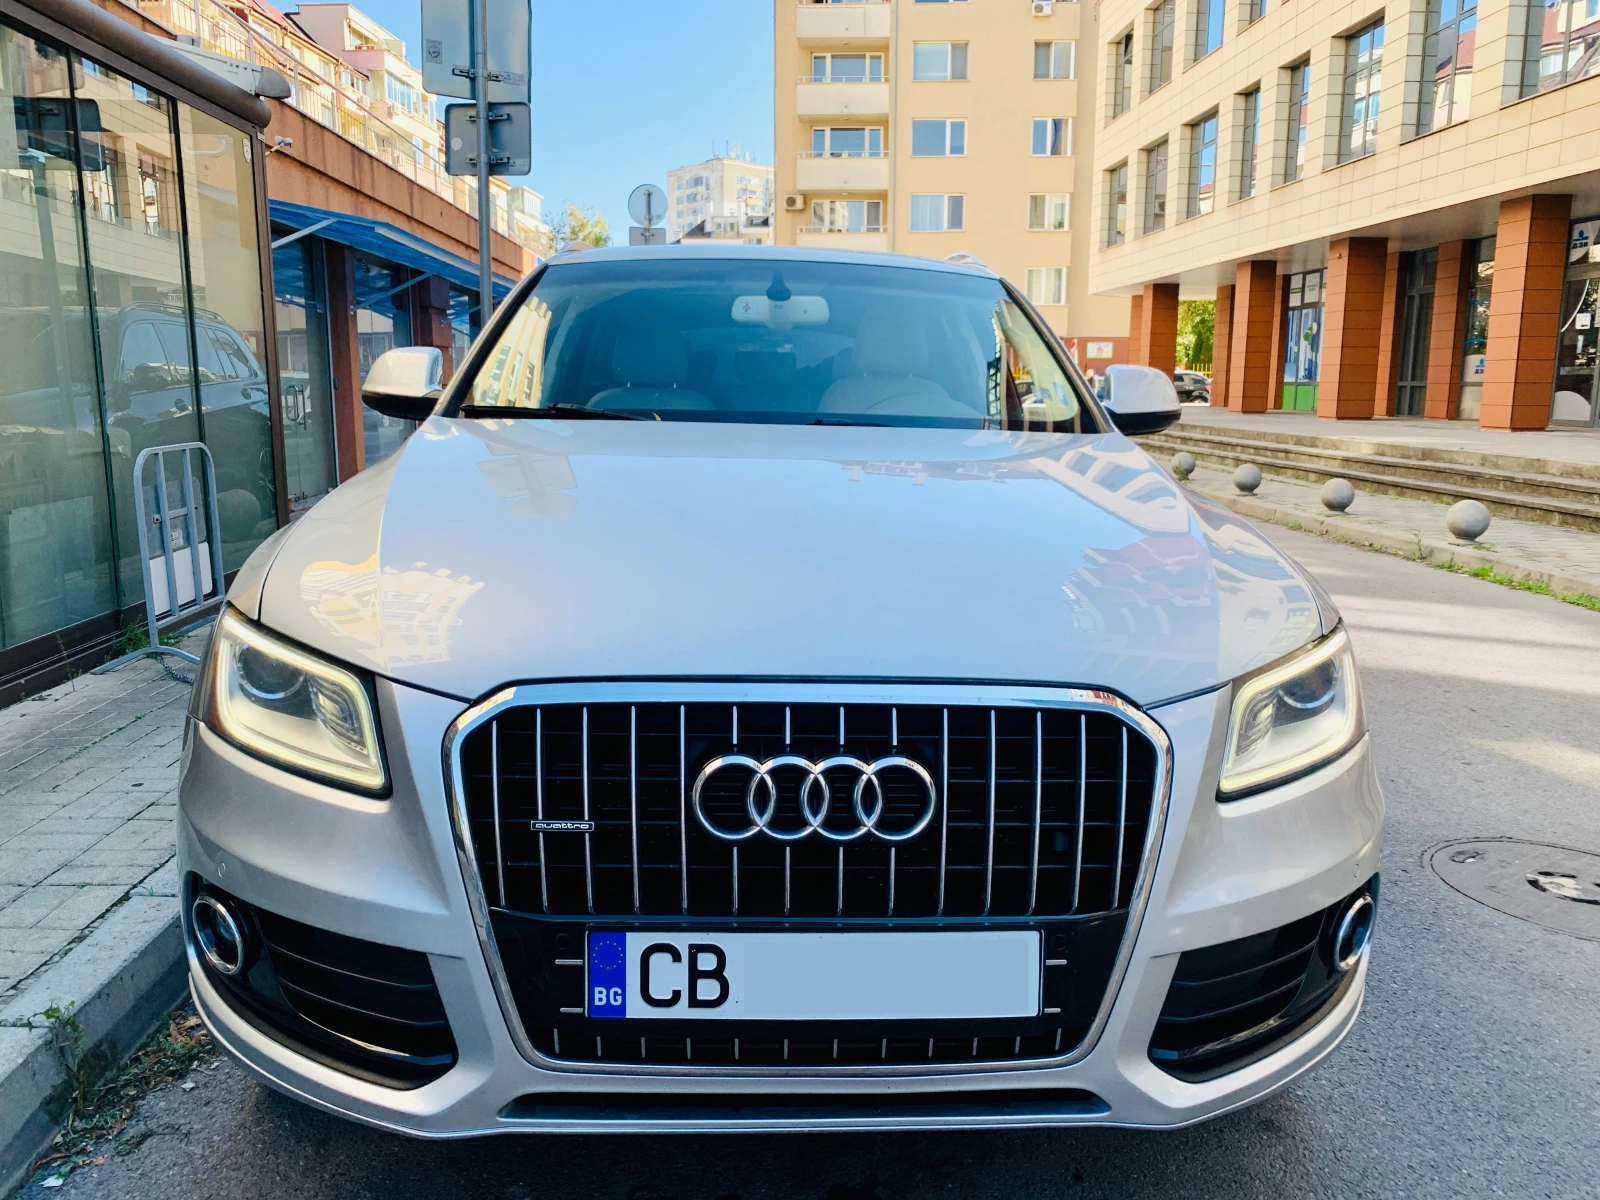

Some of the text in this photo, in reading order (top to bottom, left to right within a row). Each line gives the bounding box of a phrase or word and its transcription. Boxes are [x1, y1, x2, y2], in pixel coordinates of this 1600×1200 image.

[535, 822, 589, 830] quattro
[640, 942, 730, 1009] CB
[594, 987, 622, 1006] BG
